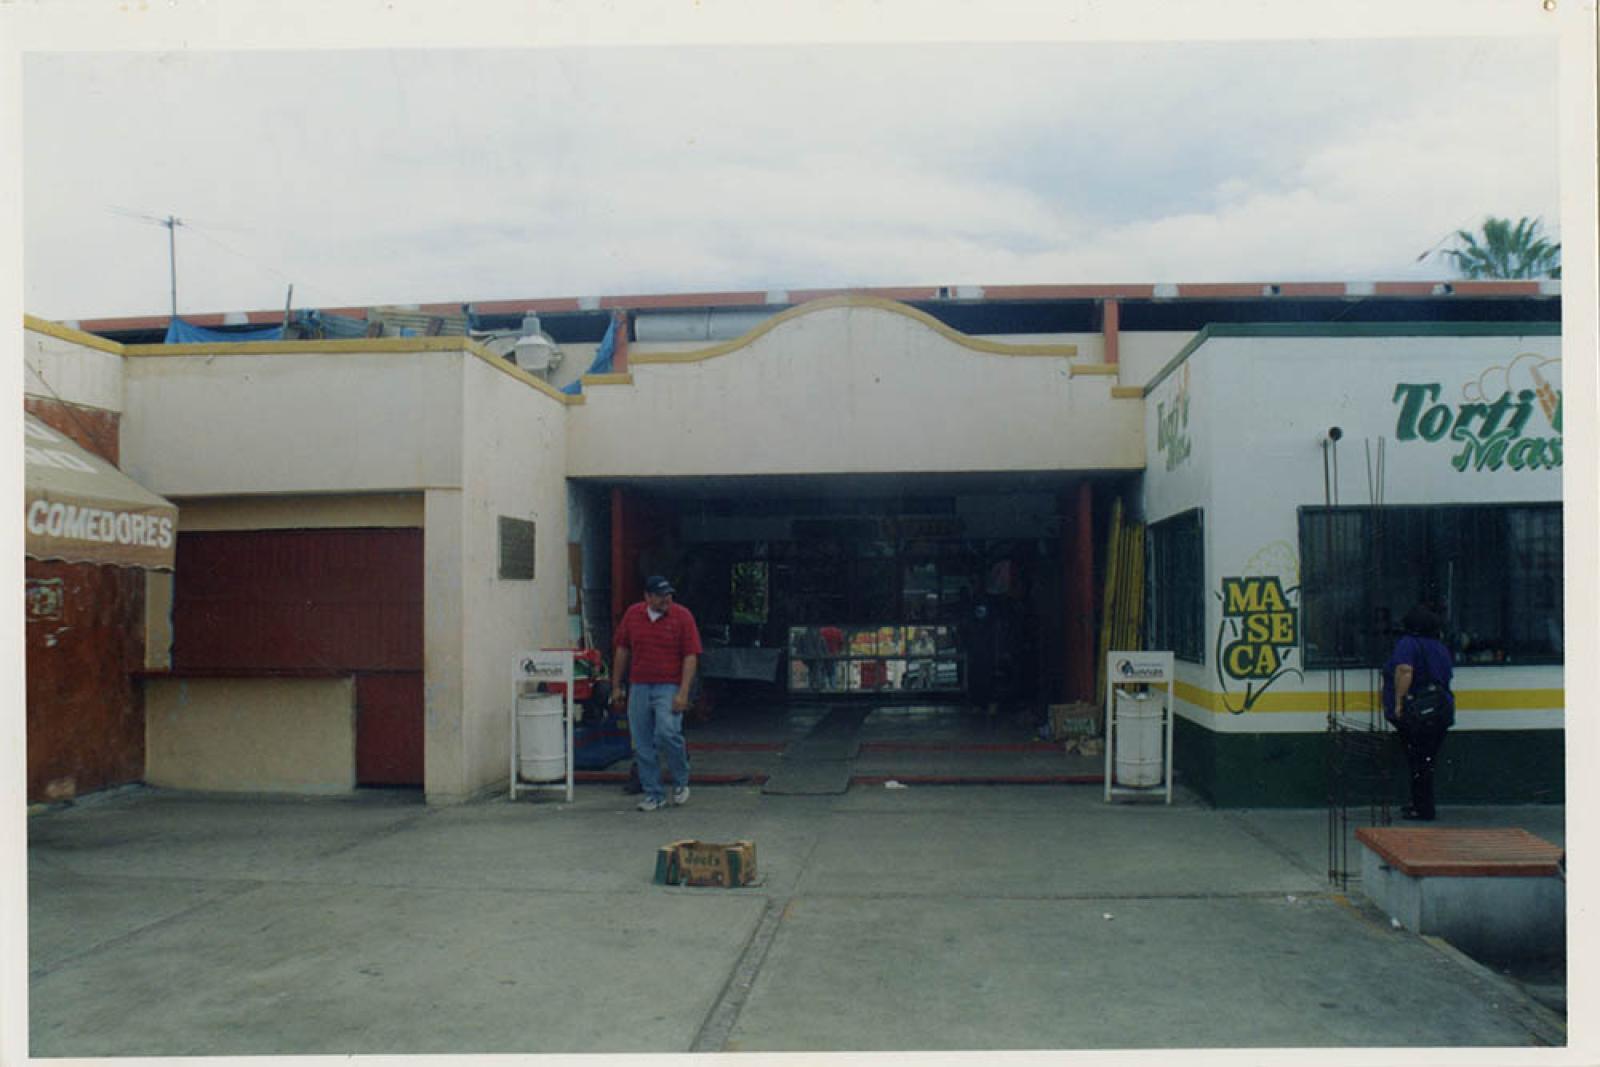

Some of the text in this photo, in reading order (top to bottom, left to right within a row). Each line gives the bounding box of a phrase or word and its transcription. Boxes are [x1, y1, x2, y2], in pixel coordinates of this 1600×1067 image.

[28, 501, 172, 548] COMEDORES
[1228, 581, 1284, 613] MA
[1247, 613, 1293, 643] SE
[1228, 643, 1277, 675] CA
